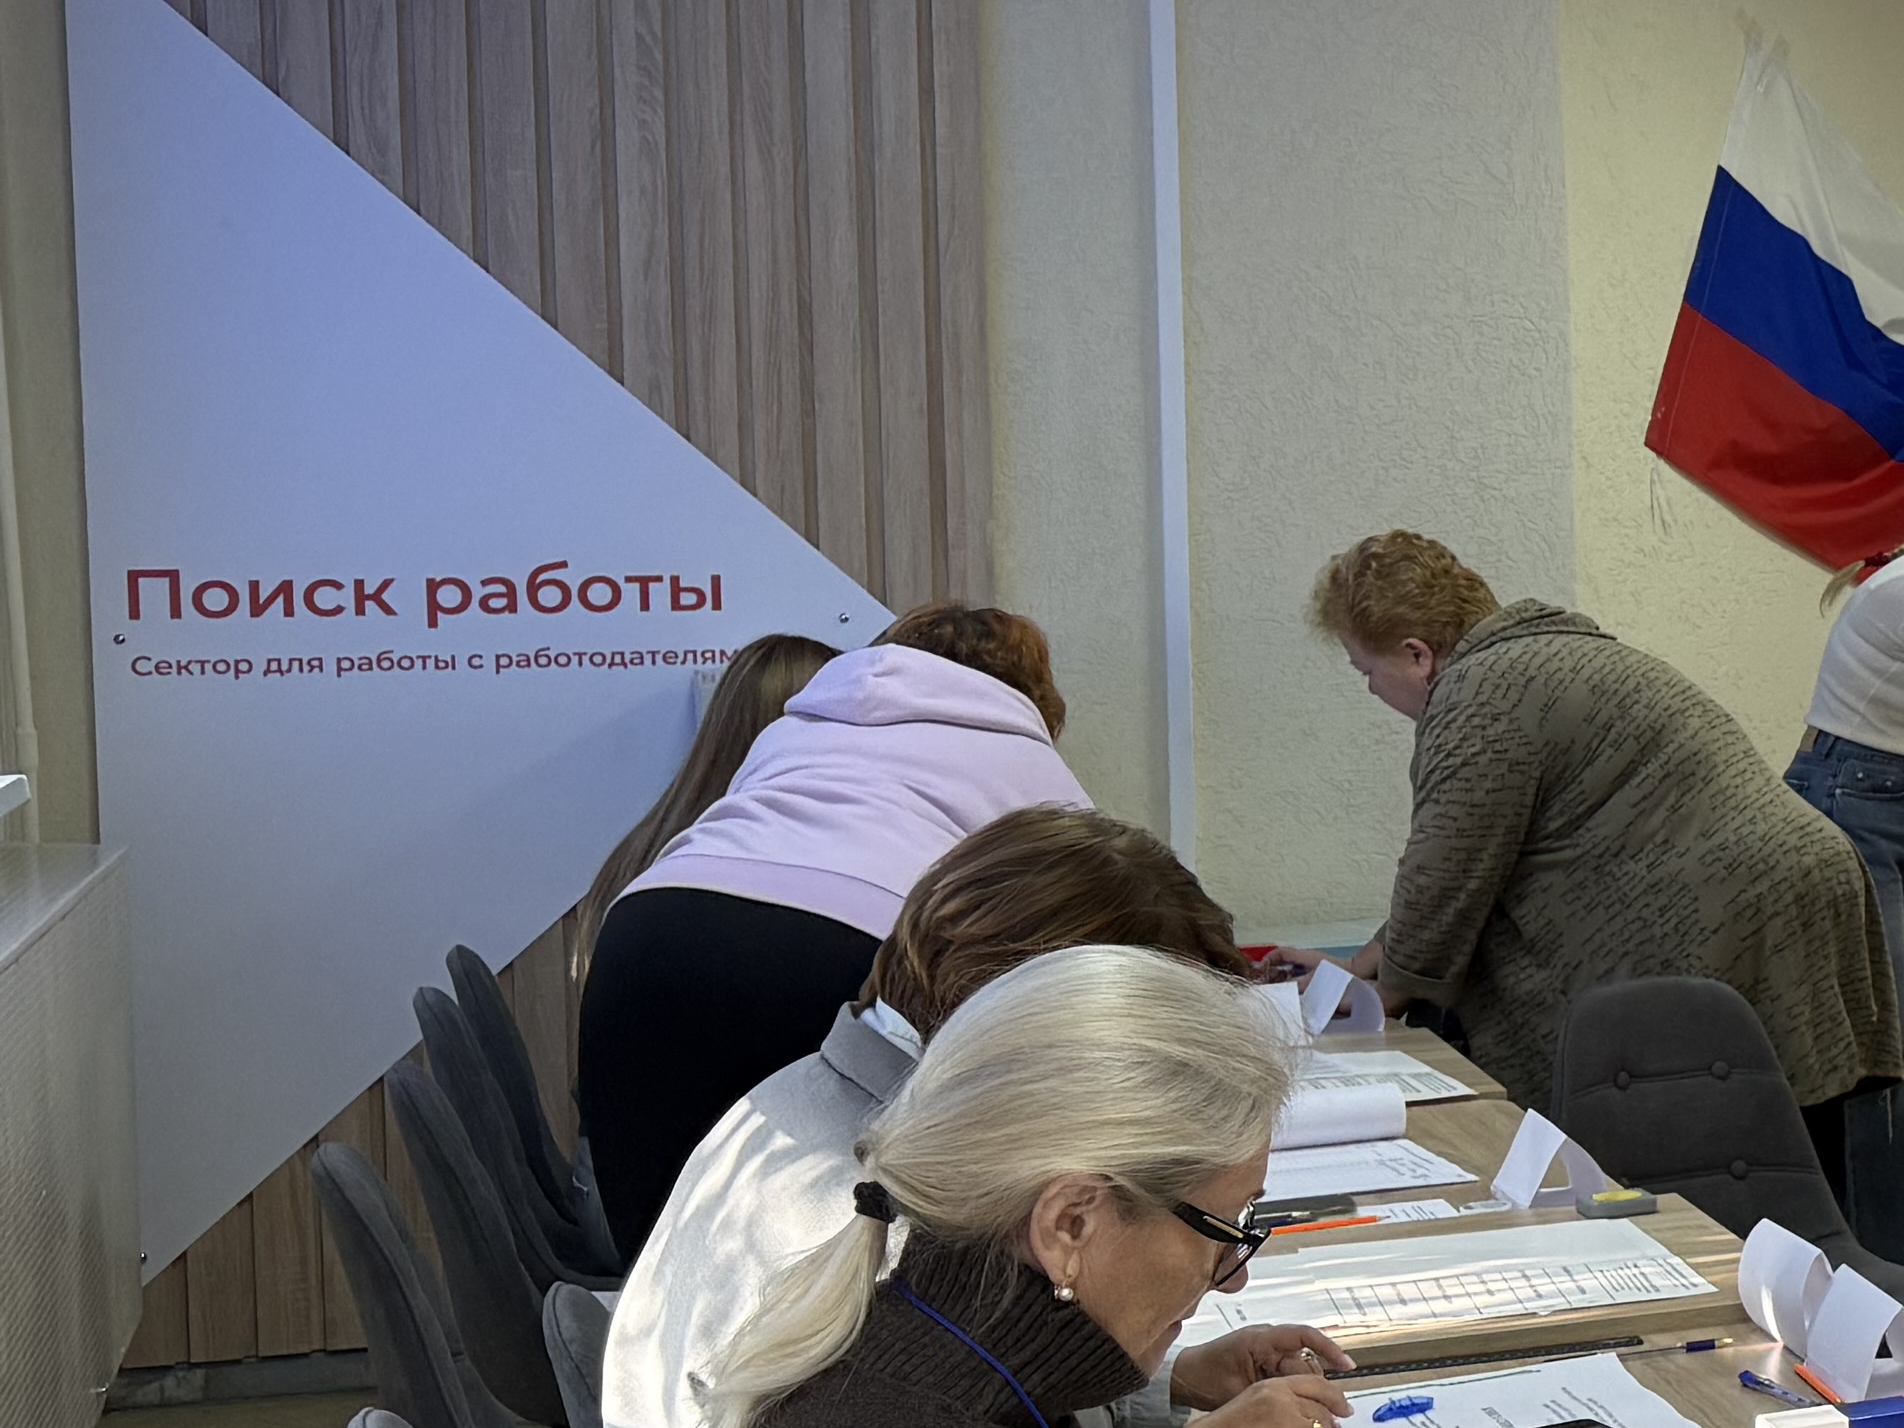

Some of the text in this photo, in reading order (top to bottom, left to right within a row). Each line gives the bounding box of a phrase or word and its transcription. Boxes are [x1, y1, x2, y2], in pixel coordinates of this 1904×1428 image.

[126, 559, 723, 631] Поиск работы
[130, 653, 256, 679] Сектор
[262, 653, 325, 678] для
[335, 649, 458, 676] работы
[467, 655, 485, 671] с
